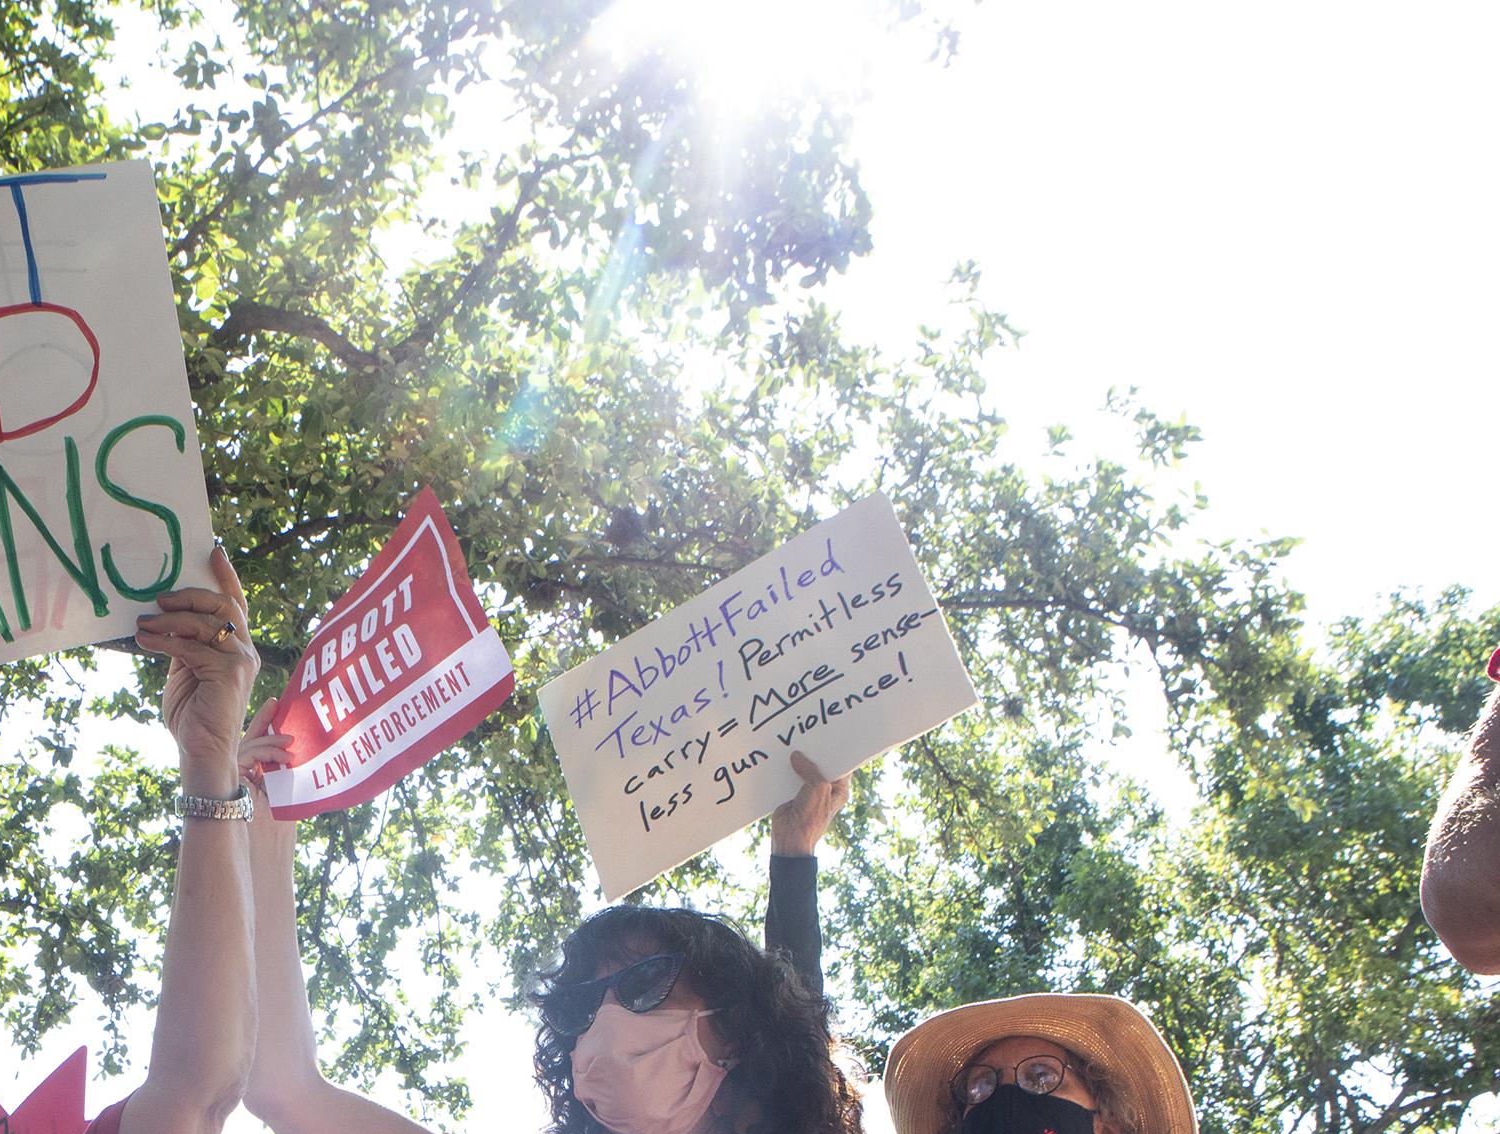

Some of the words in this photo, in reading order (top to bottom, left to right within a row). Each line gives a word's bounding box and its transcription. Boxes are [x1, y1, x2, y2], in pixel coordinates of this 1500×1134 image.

[299, 574, 414, 693] ABBOTT
[310, 623, 423, 734] FAILED
[738, 572, 904, 680] Permitless
[311, 755, 355, 790] LAW
[351, 661, 473, 765] ENFORCEMENT
[640, 782, 694, 833] less
[713, 747, 769, 805] gun
[777, 651, 914, 746] violence!
[748, 662, 836, 727] More
